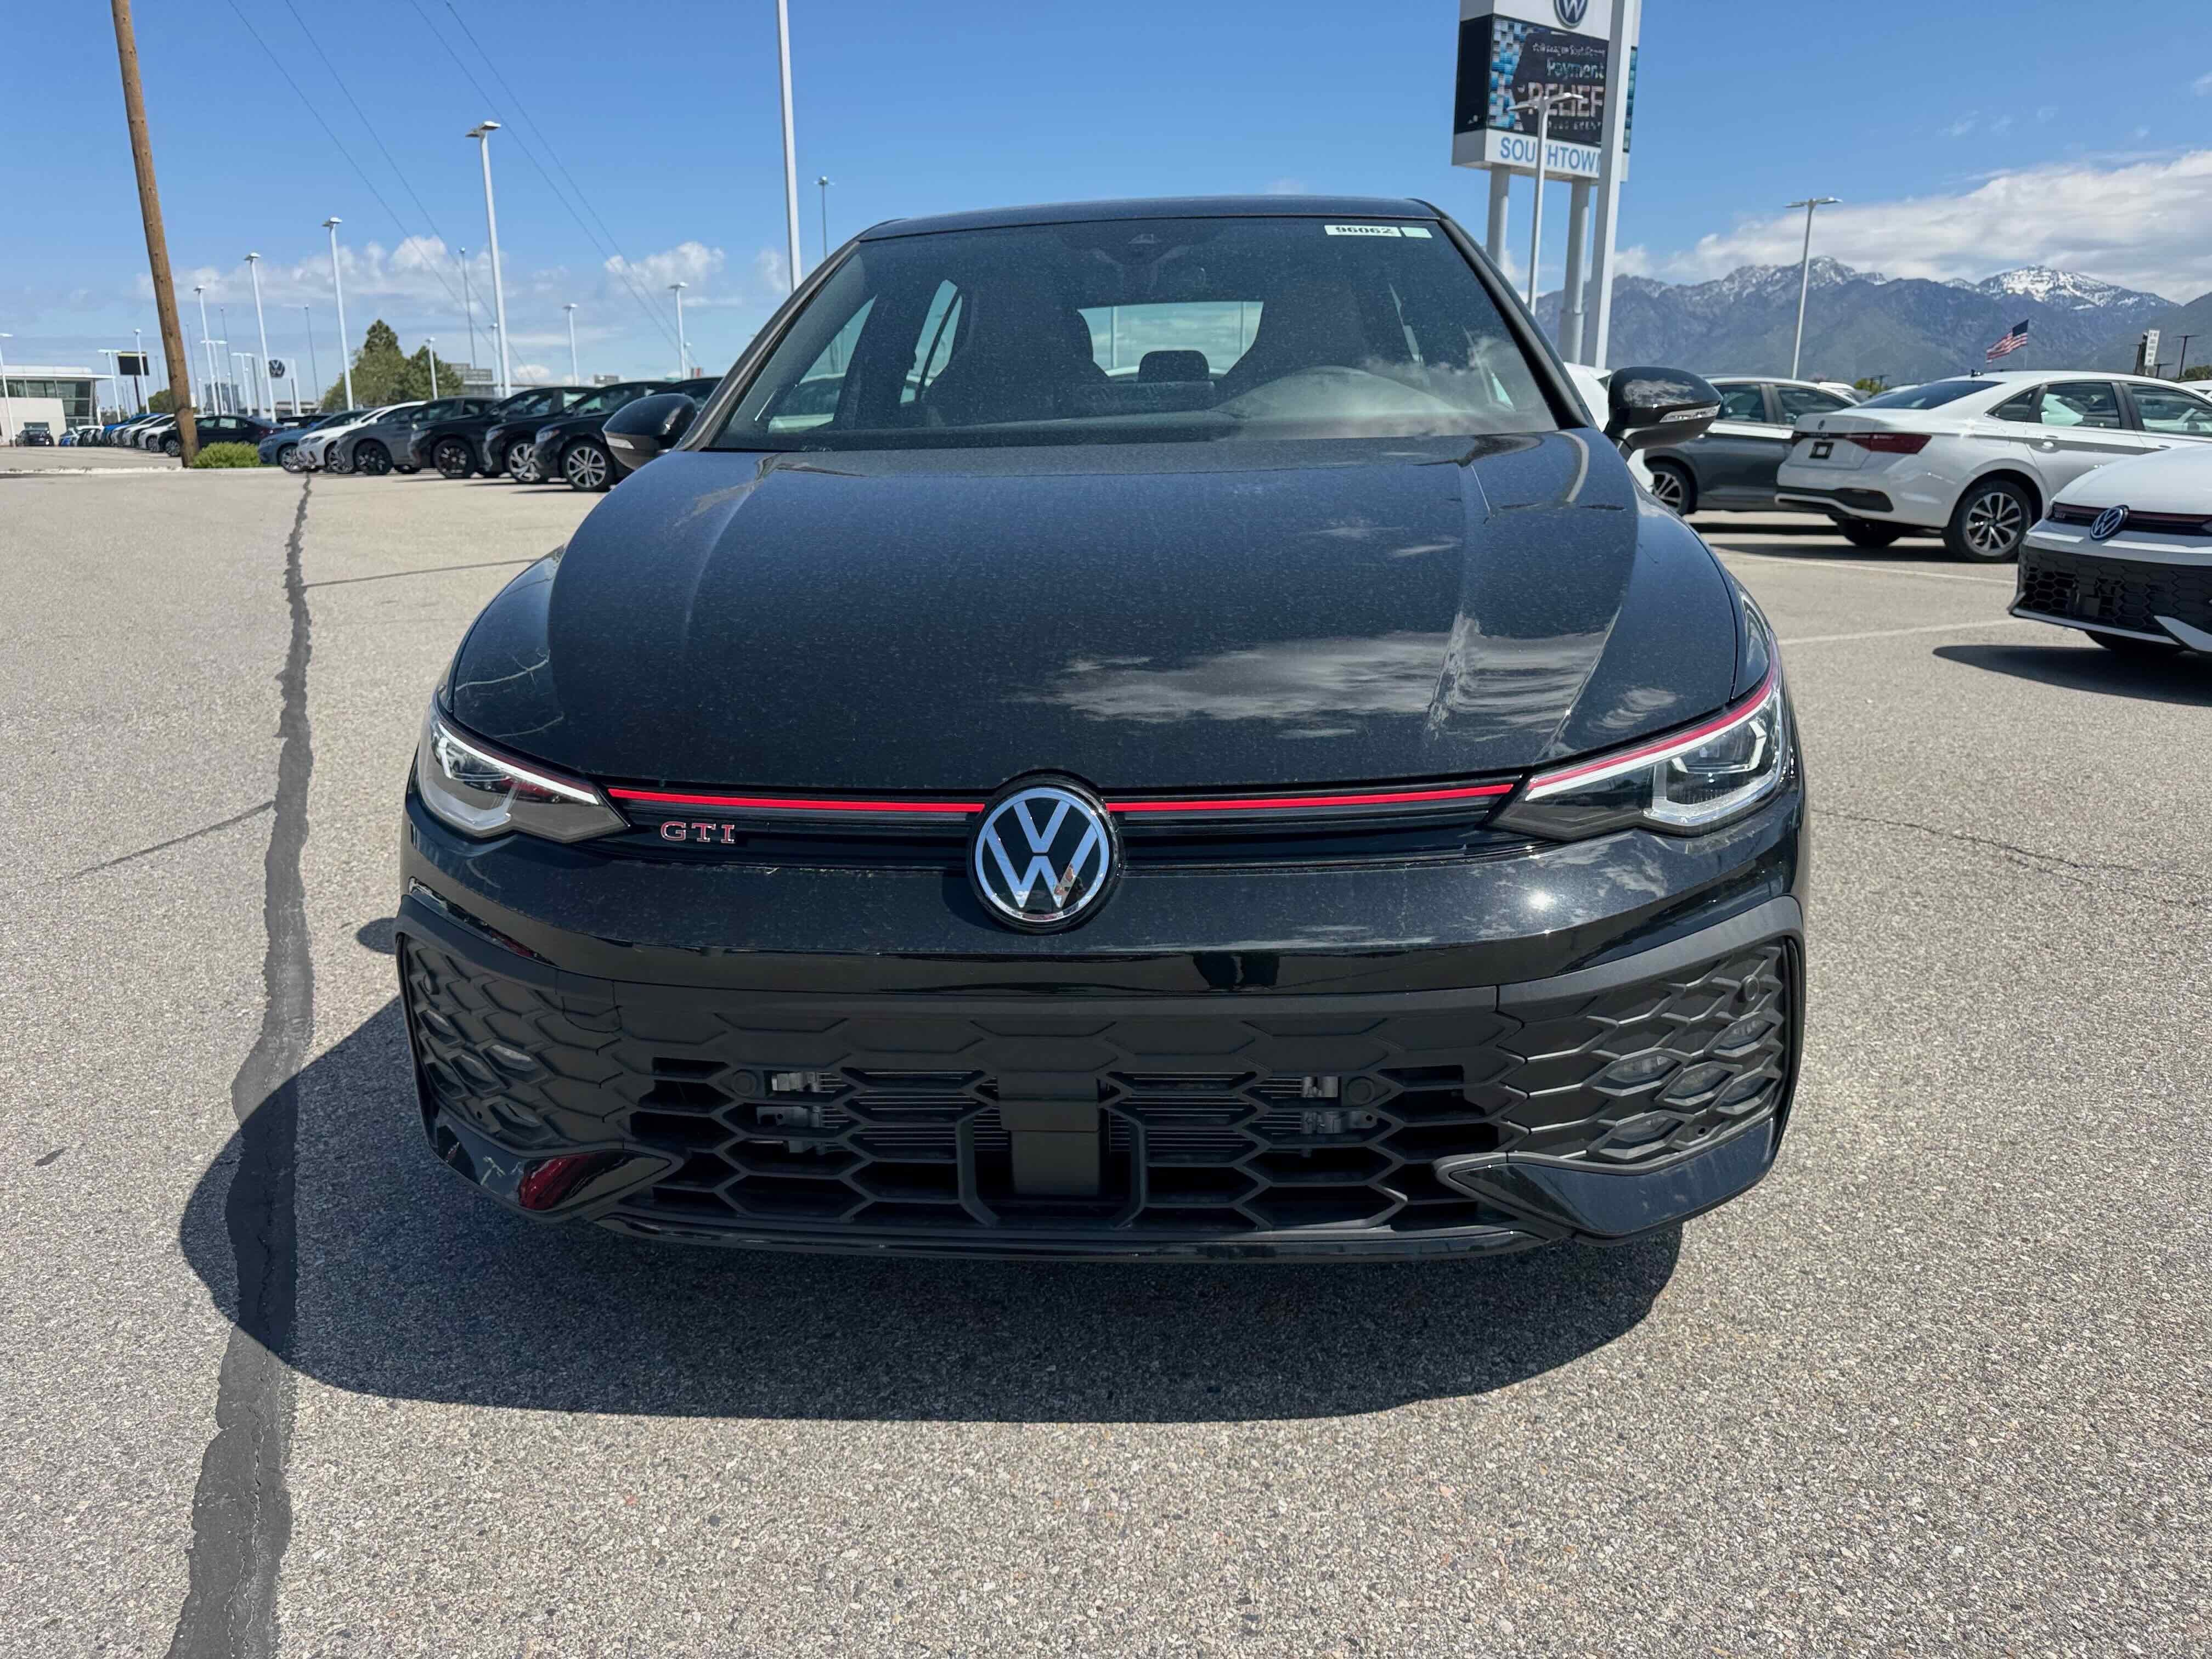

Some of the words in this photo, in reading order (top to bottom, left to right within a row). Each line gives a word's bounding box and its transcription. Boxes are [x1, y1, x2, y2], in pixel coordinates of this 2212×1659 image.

[1500, 137, 1601, 174] SOUHTOW
[661, 821, 735, 844] GTI
[979, 793, 1104, 915] VW
